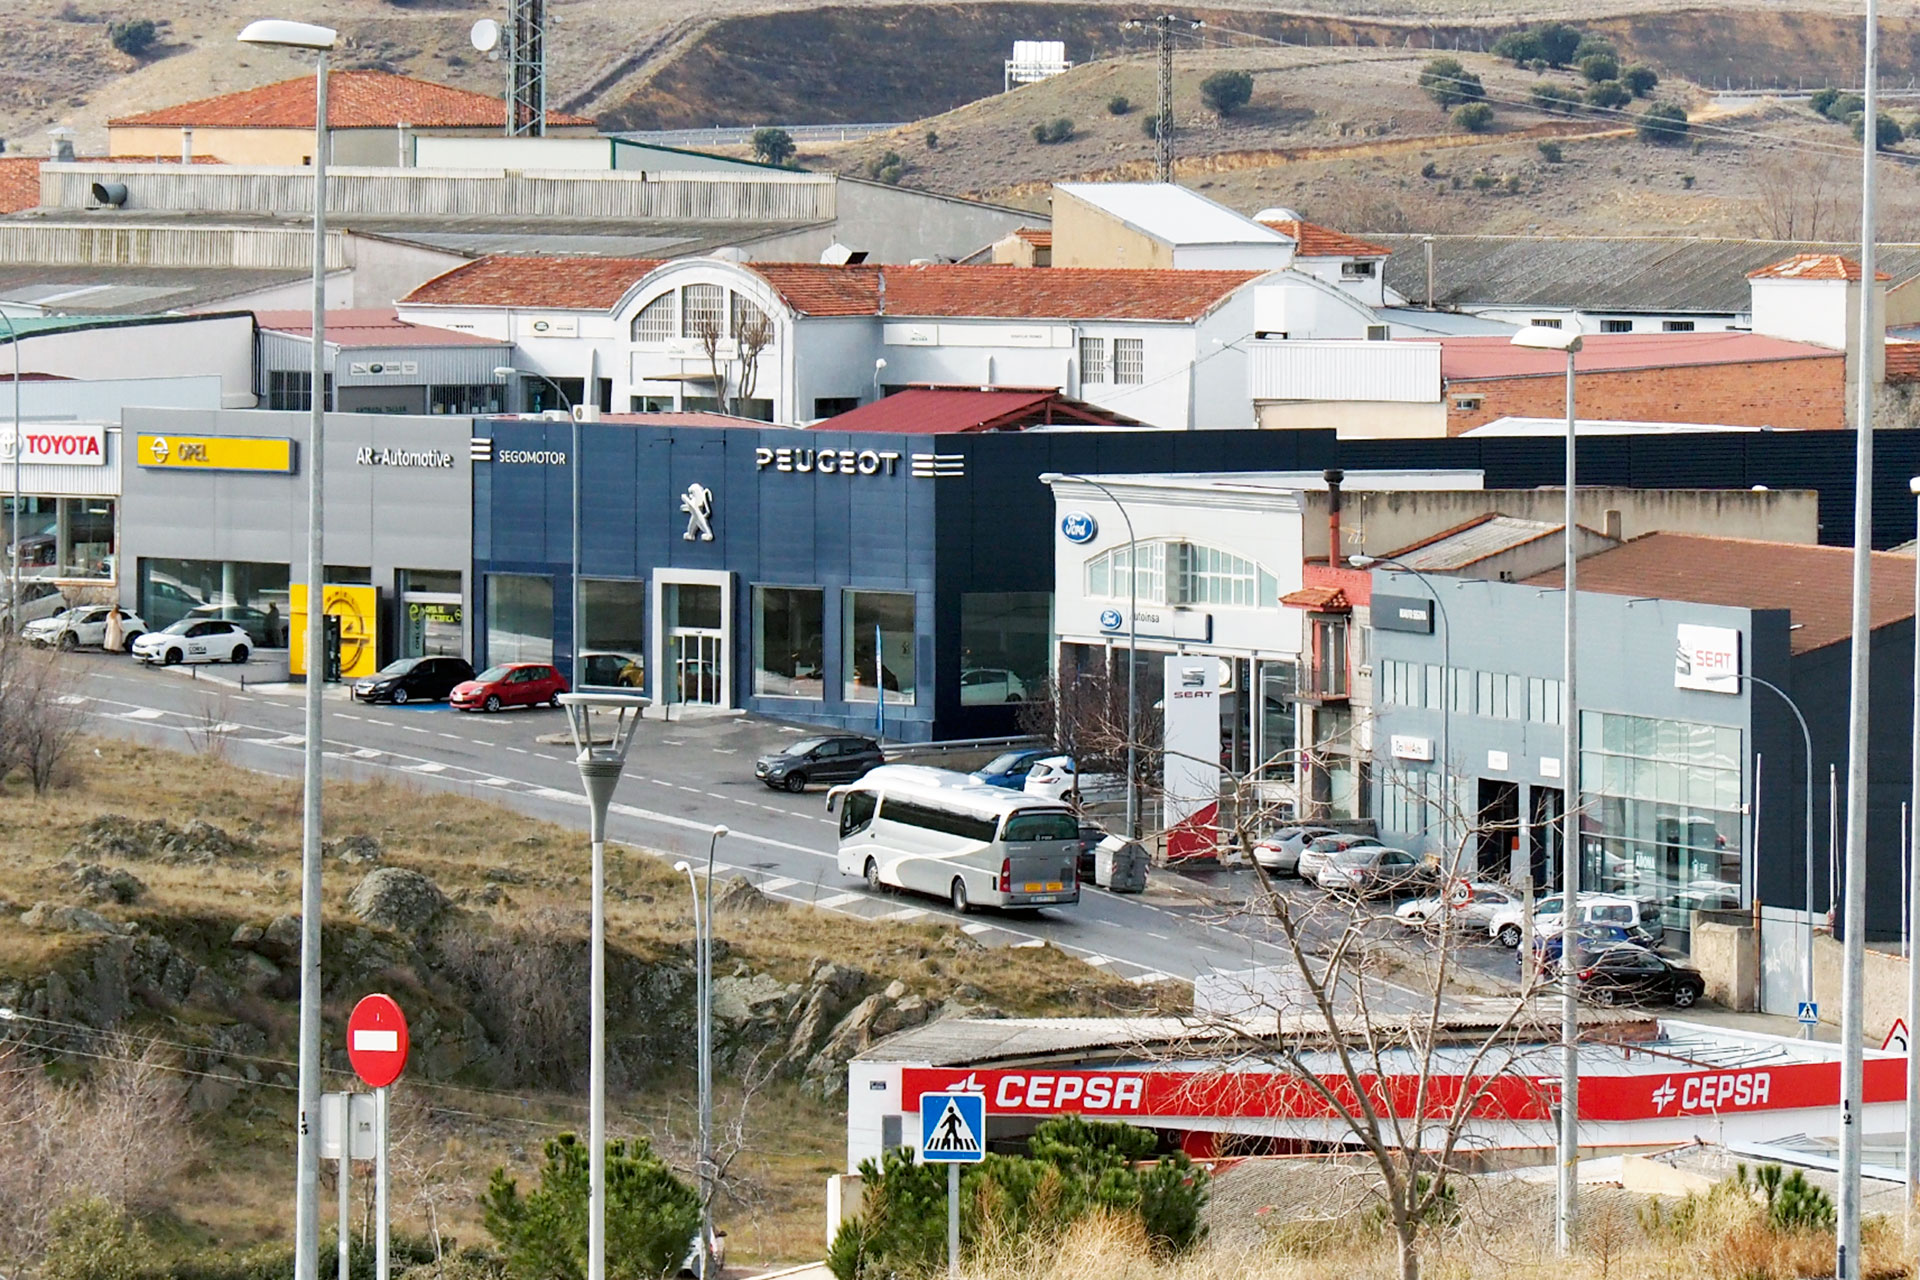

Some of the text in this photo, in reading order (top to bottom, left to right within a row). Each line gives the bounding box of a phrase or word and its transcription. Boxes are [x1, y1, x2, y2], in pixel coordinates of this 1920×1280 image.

[26, 434, 100, 455] TOYOTA
[178, 441, 210, 462] OPEL
[499, 449, 567, 465] SEGOMOTOR
[755, 447, 900, 476] PEUGEOT
[1696, 650, 1731, 669] SEAT
[1174, 691, 1213, 699] SEAT
[995, 1075, 1144, 1109] CEPSA
[1682, 1072, 1770, 1110] CEPSA
